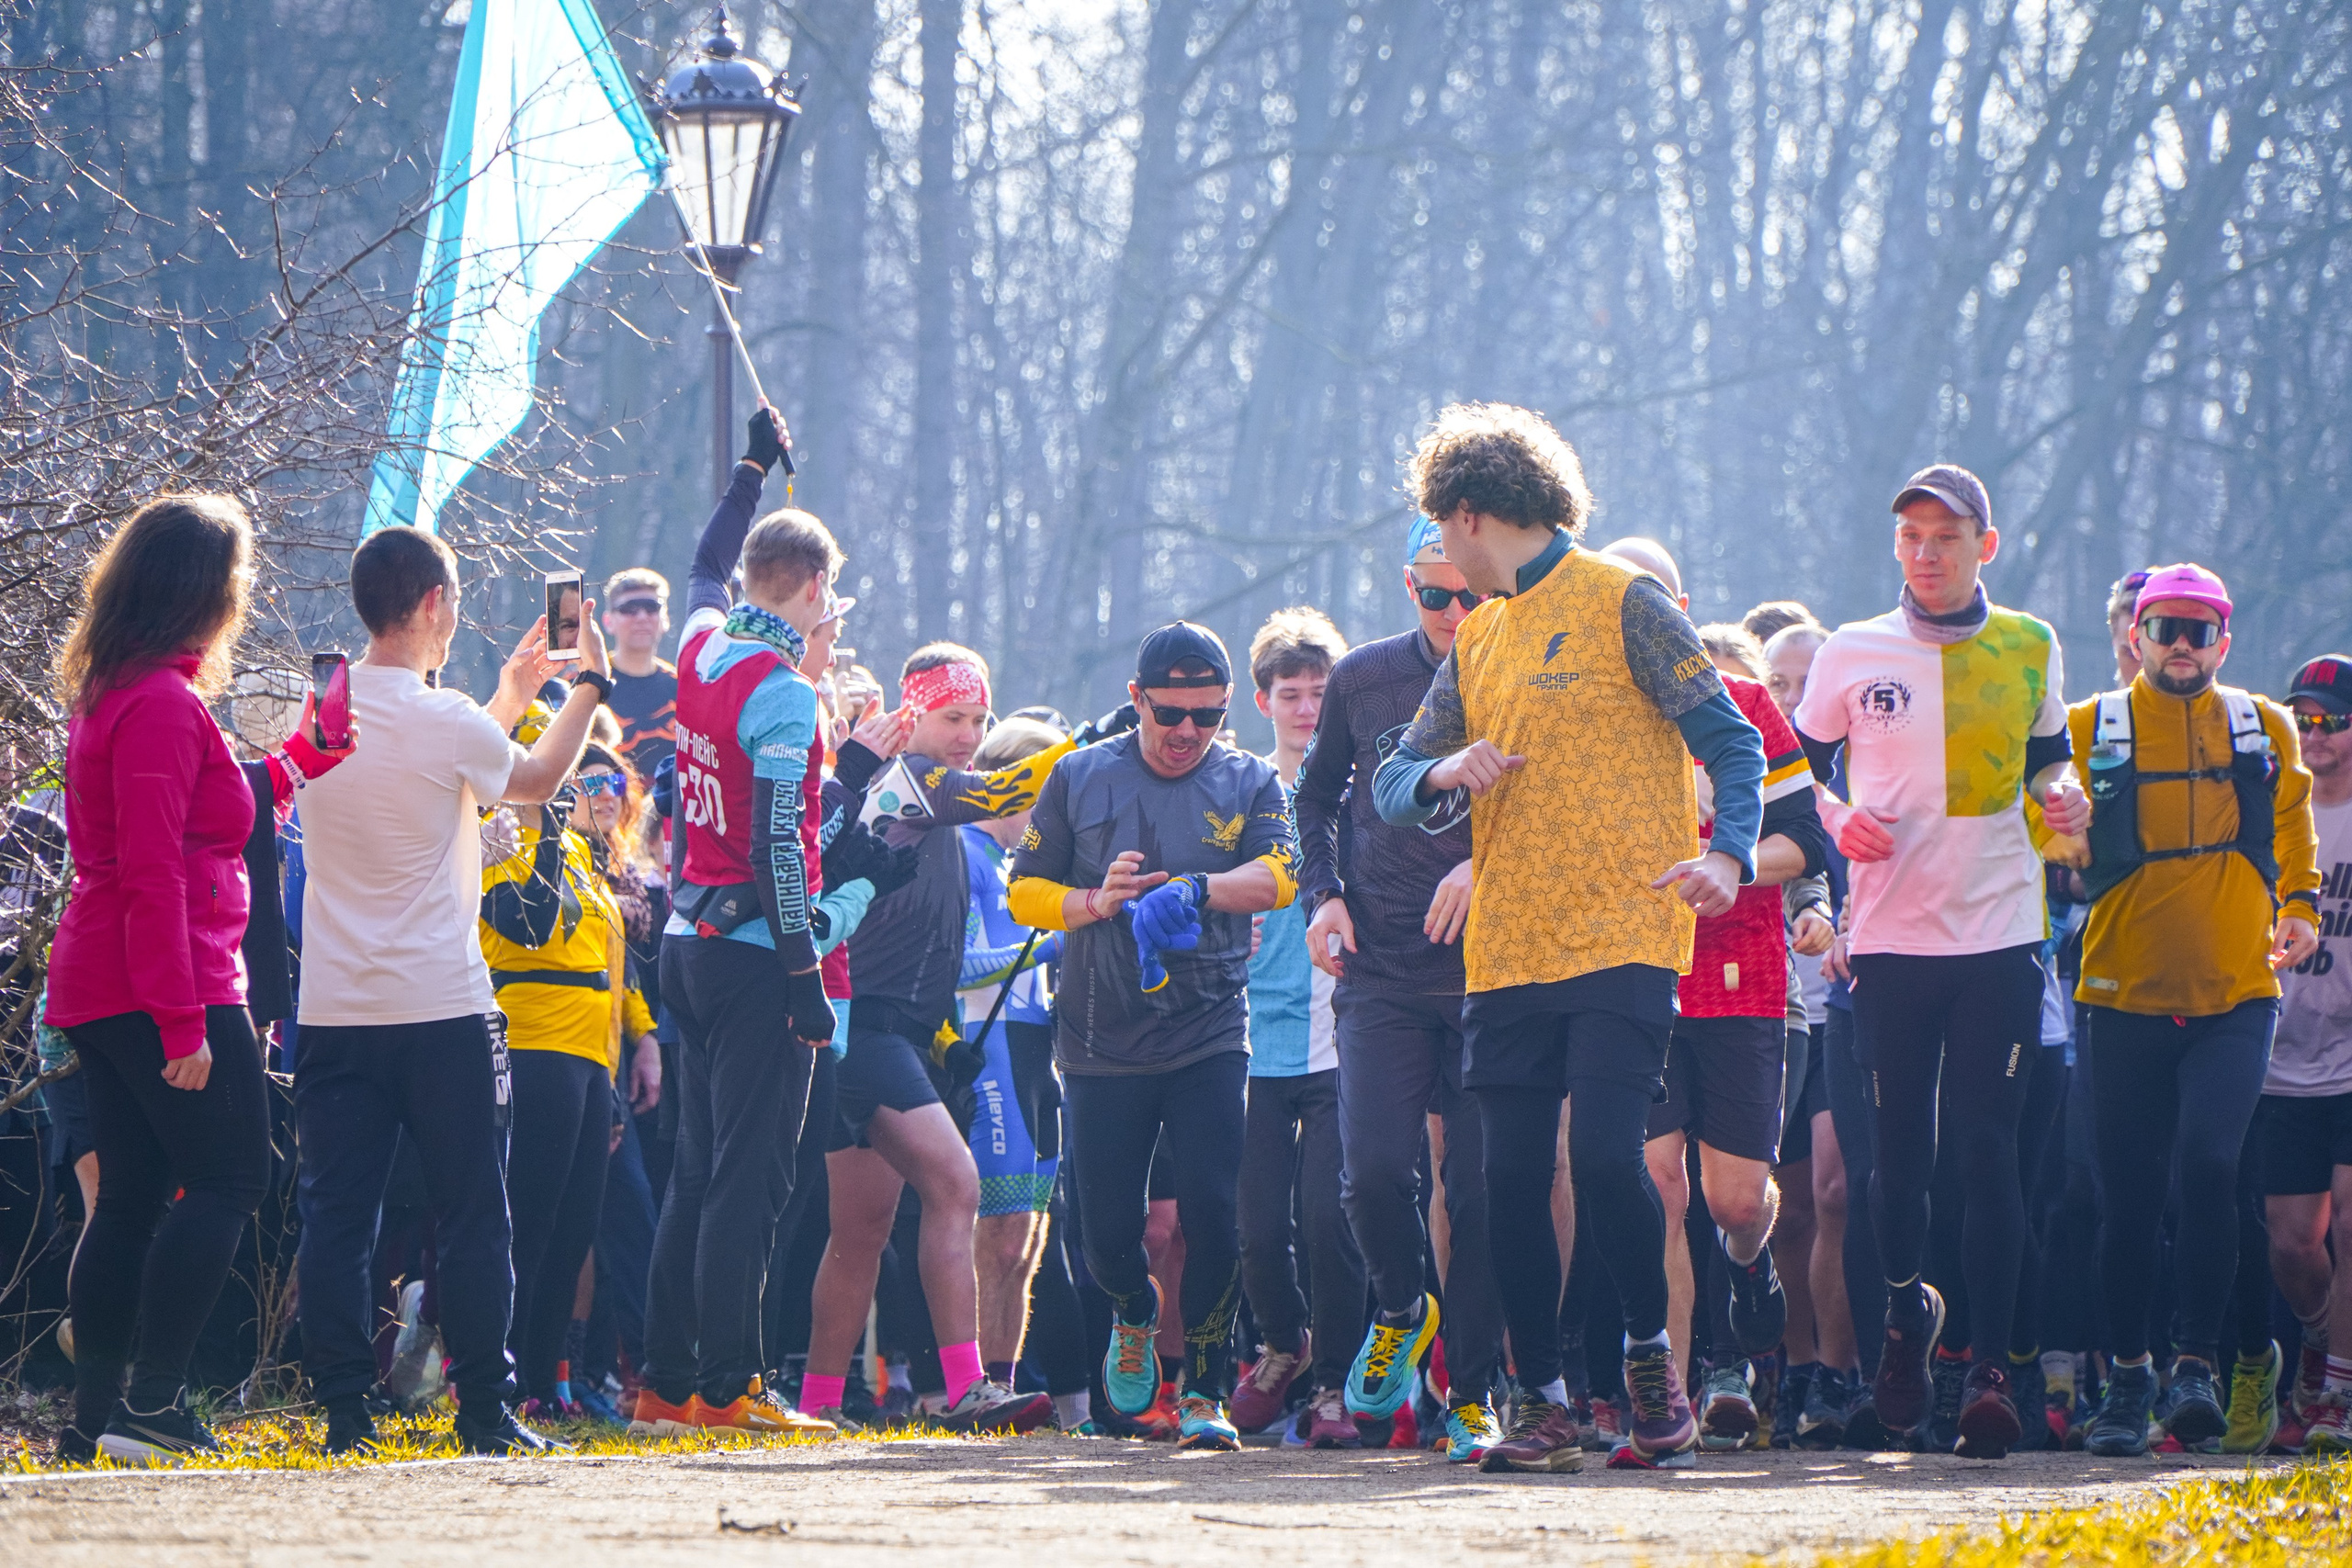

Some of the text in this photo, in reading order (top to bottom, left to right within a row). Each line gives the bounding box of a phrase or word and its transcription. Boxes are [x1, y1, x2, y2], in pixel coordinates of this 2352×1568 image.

[1528, 672, 1579, 685] ШОКЕР
[1874, 690, 1894, 713] 5
[675, 721, 719, 770] ПИ-ПЕЙС
[1225, 842, 1236, 852] 50
[773, 842, 806, 932] КАПИБАРА
[1087, 998, 1095, 1028] HEROES
[2006, 1043, 2021, 1077] FUSION
[980, 1078, 1007, 1156] Mievco
